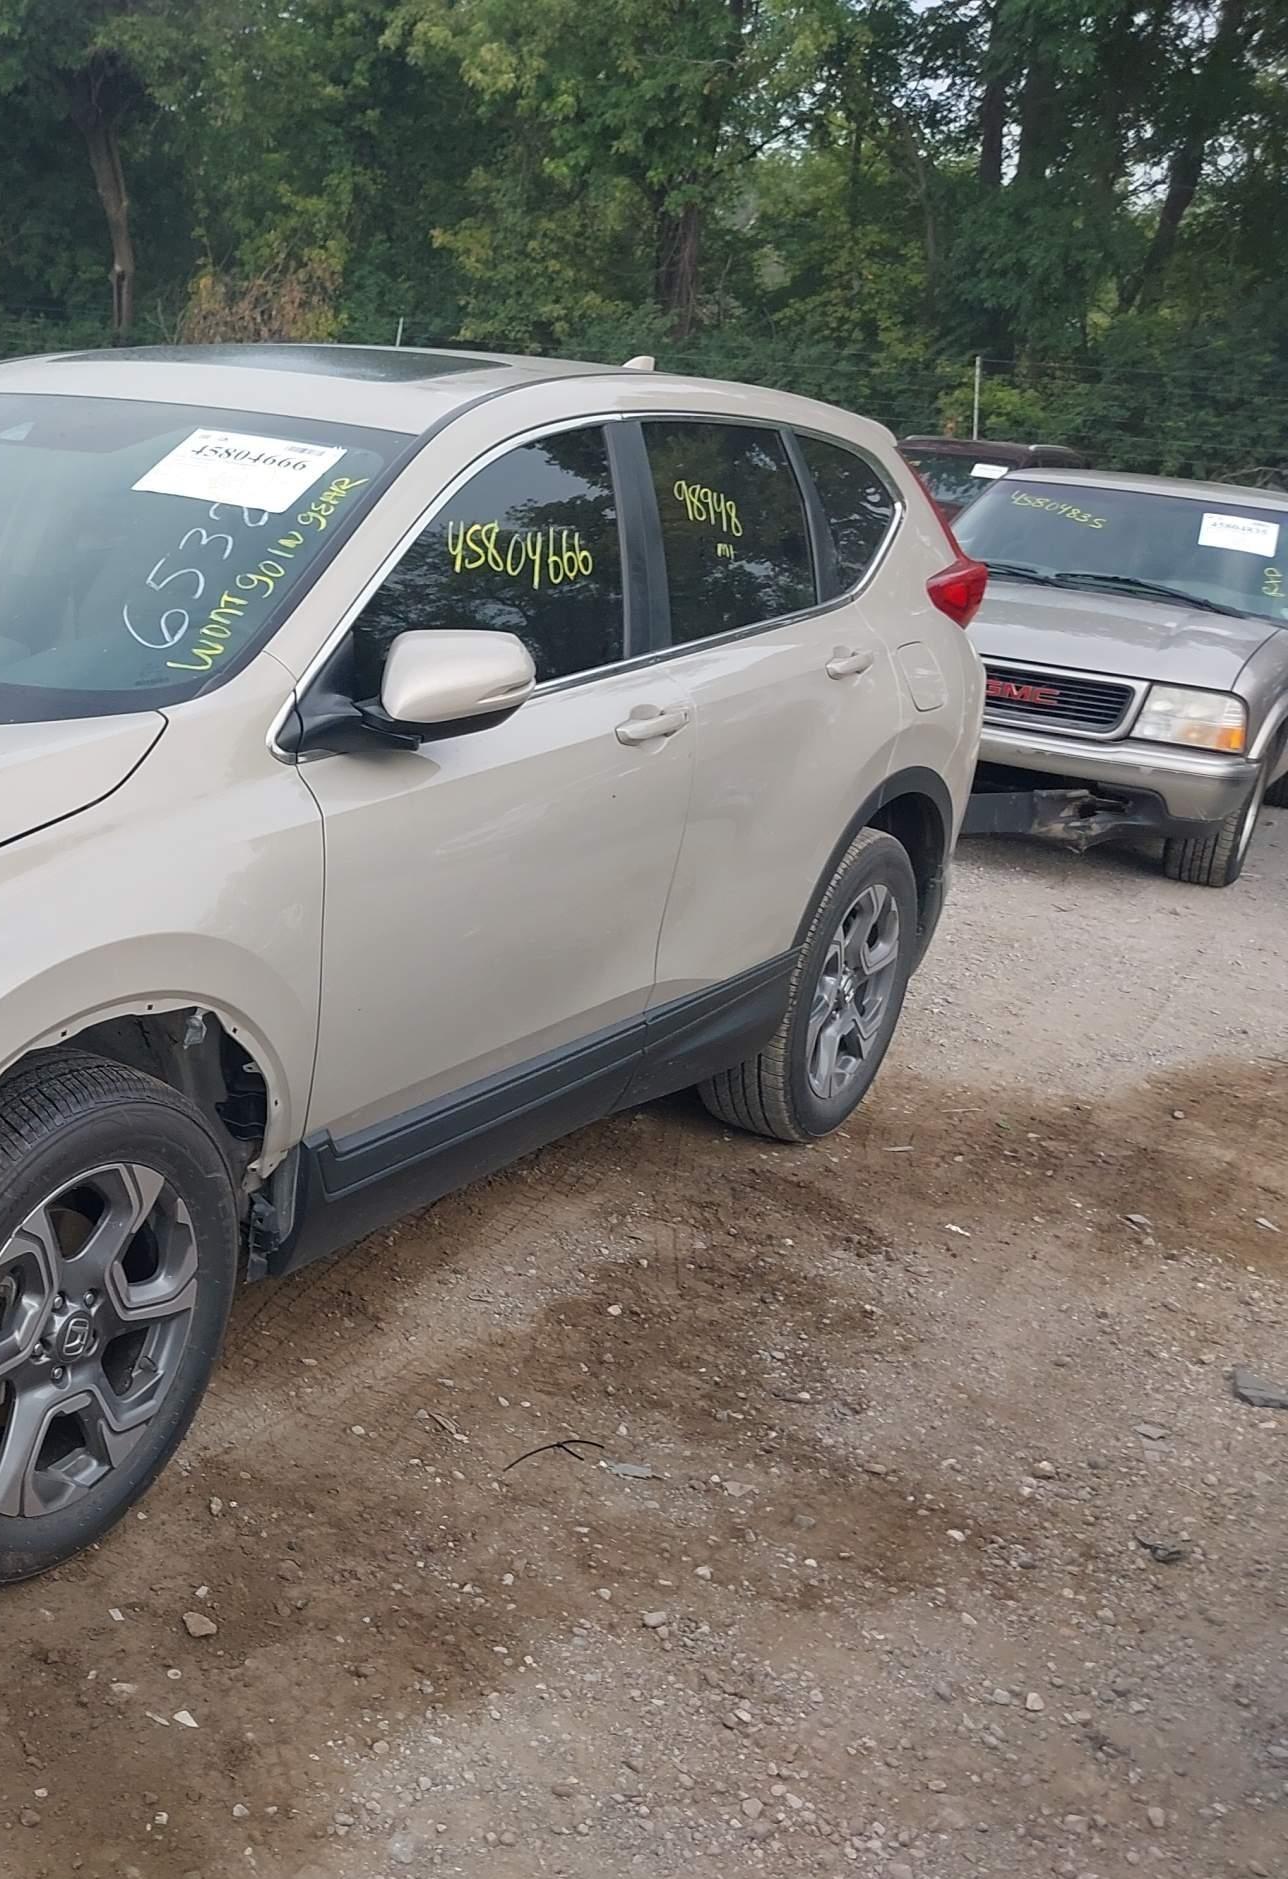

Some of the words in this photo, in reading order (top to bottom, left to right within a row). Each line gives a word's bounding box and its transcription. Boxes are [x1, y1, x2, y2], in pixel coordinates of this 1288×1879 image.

[192, 444, 310, 472] 45804666
[673, 480, 743, 537] 98948
[1011, 490, 1107, 529] 45804835
[448, 519, 593, 590] 45804666
[985, 679, 1060, 706] GMC
